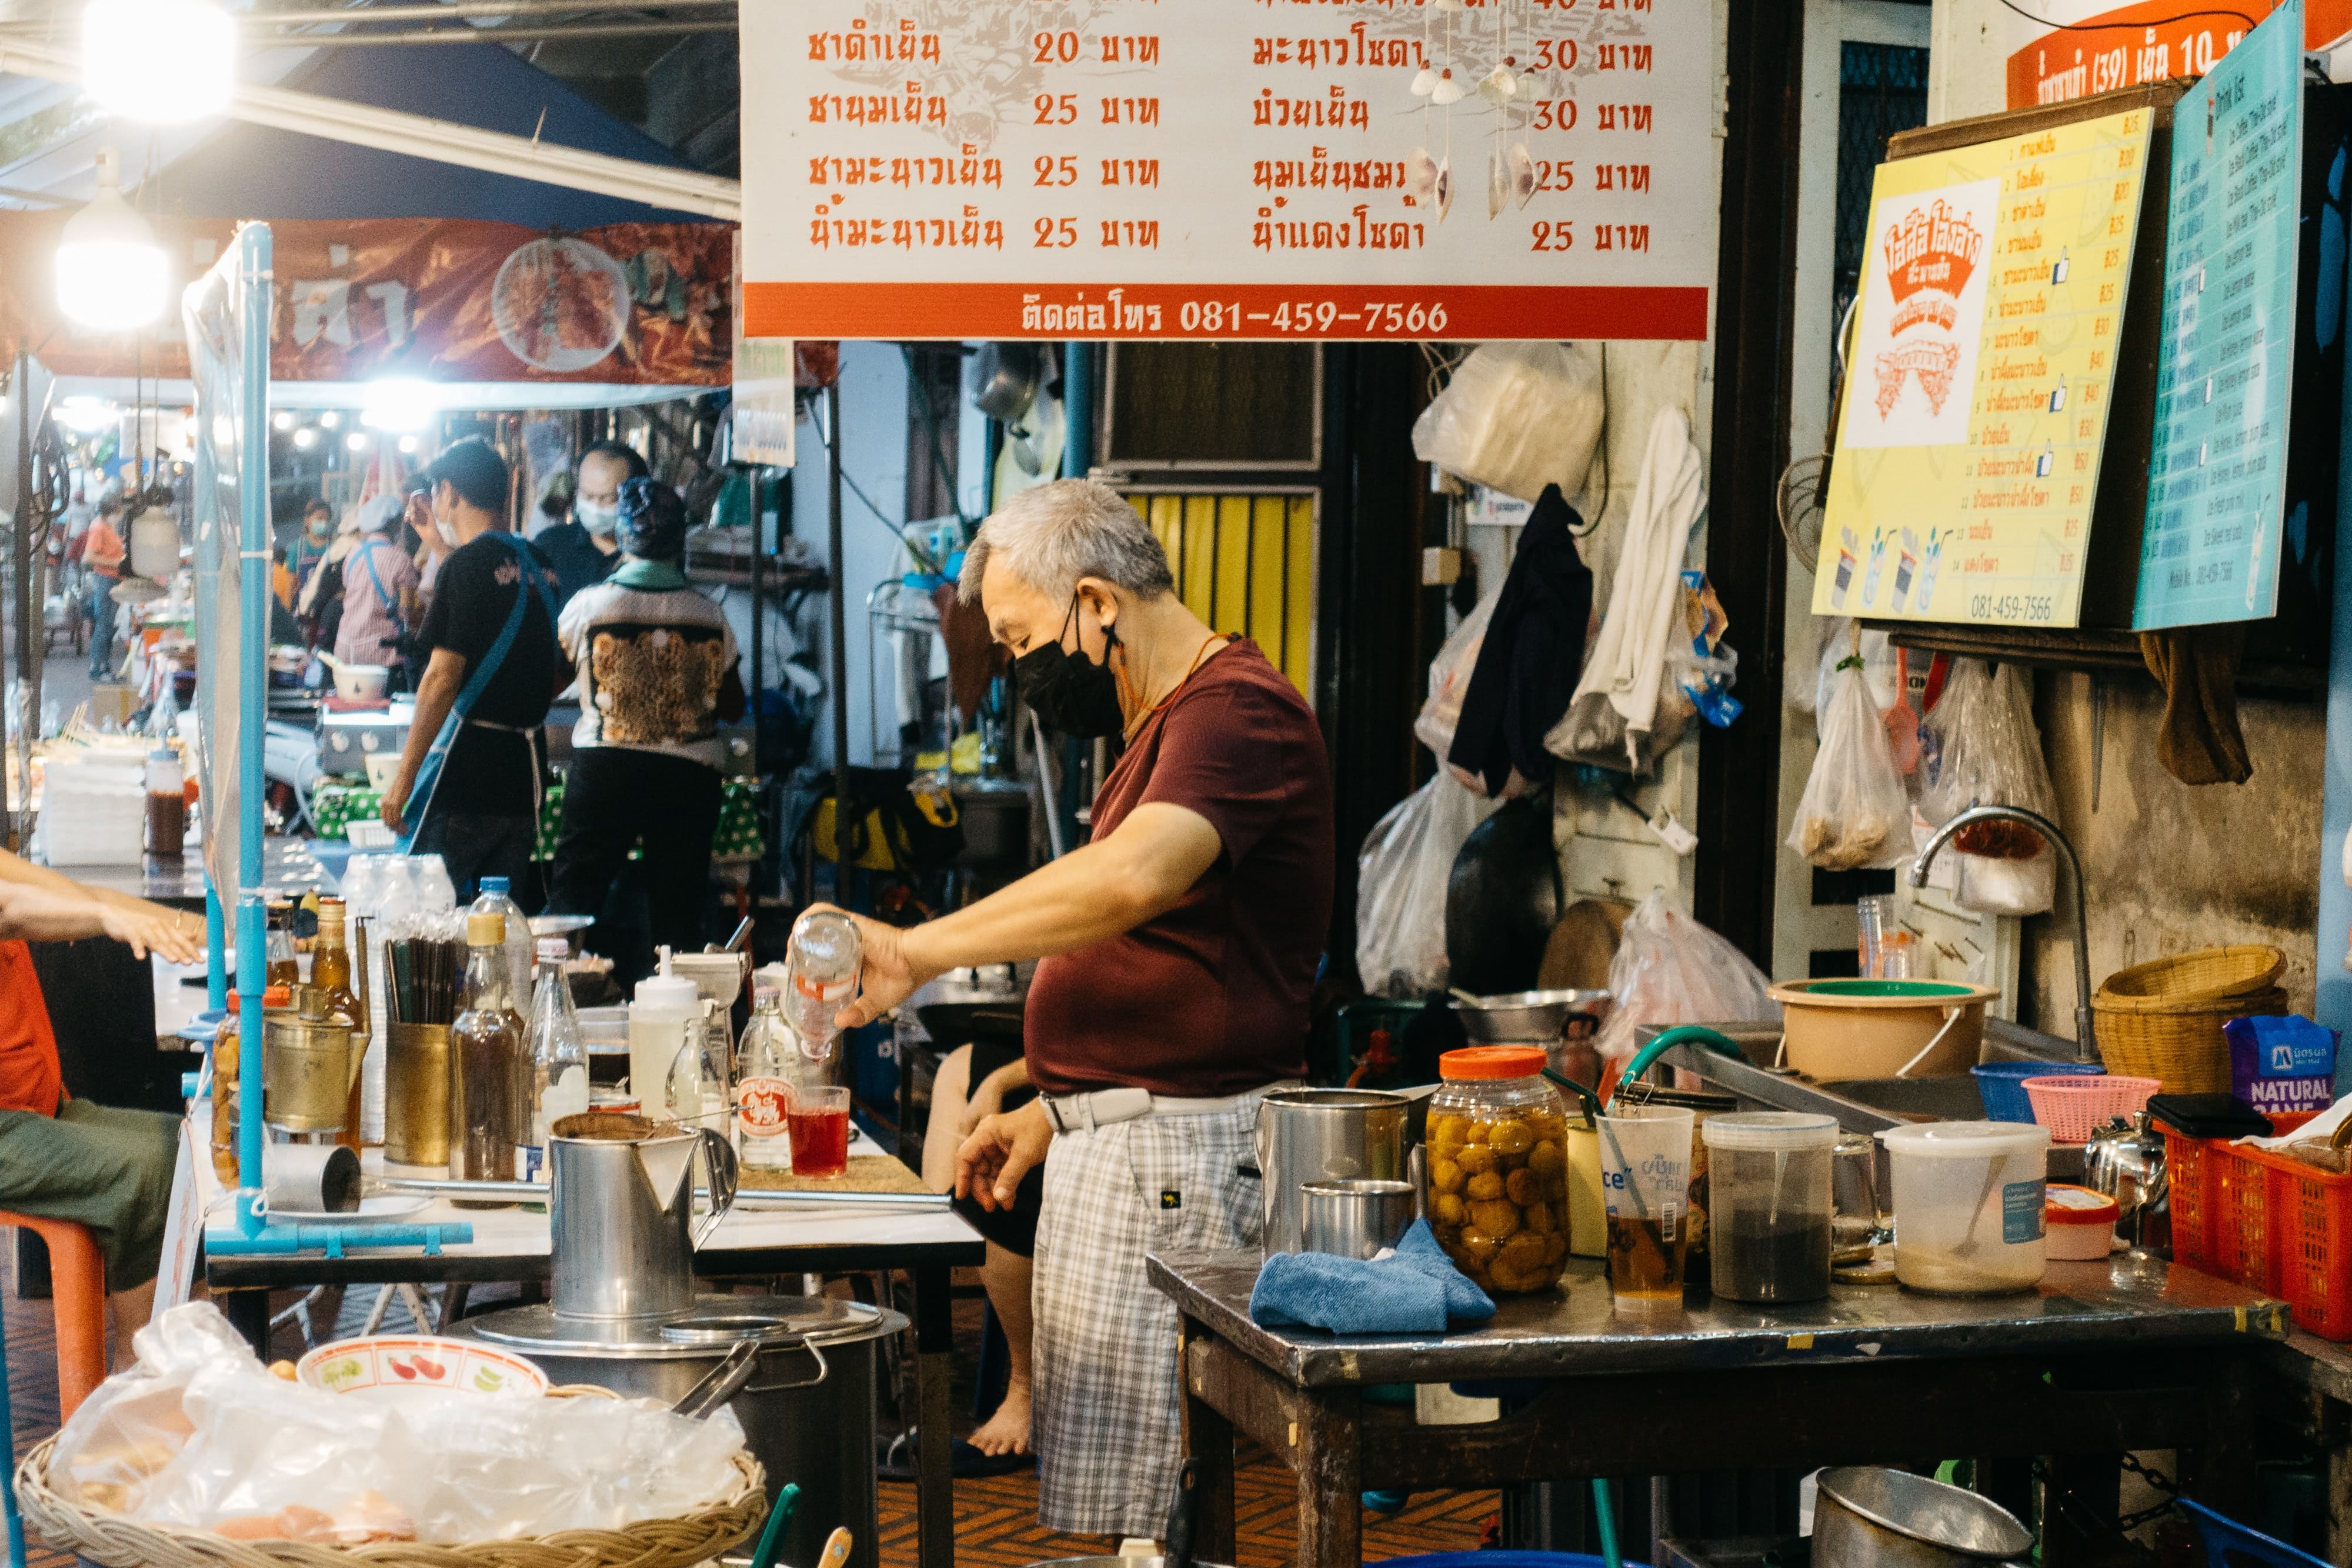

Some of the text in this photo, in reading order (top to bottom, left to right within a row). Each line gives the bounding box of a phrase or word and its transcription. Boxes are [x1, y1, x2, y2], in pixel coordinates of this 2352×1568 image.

[808, 18, 1159, 65] ชาดำเย็น 20 บาท
[1253, 21, 1653, 73] มะนาวโซดา 30 บาท
[809, 81, 1159, 126] ชานมเย็น 25 บาท
[1533, 99, 1578, 132] 30
[1597, 104, 1653, 134] บาท
[809, 143, 1159, 189] ชามะนาวเย็น 25 บาท
[1595, 164, 1650, 194] บาท
[810, 193, 1159, 250] น้ำมะนาวเย็น 25 บาท
[1253, 196, 1650, 254] น้ำแดงโซดา 25 บาท
[1022, 288, 1161, 331] ติดต่อโทร
[1971, 595, 2051, 620] 081-459-7566
[2251, 1080, 2330, 1102] NATURAL
